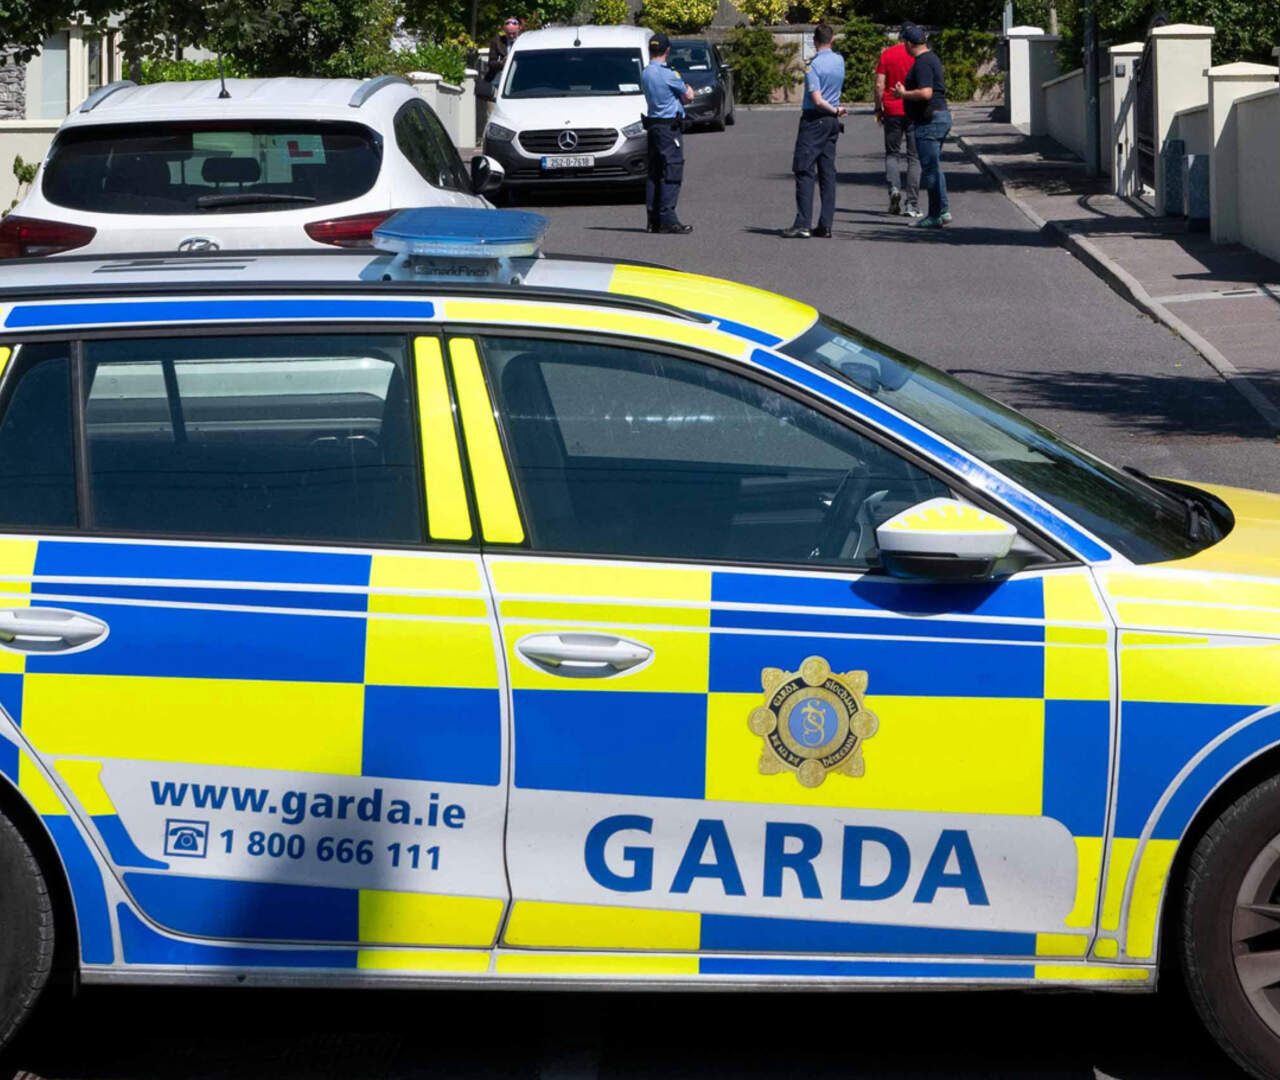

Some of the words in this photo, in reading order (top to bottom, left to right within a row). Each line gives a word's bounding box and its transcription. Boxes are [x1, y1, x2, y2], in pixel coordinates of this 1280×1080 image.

[287, 141, 313, 158] L
[150, 780, 467, 829] www.garda.ie
[220, 829, 234, 854] 1
[247, 831, 306, 860] 800
[316, 837, 374, 865] 666
[387, 842, 441, 871] 111
[584, 814, 990, 906] GARDA
